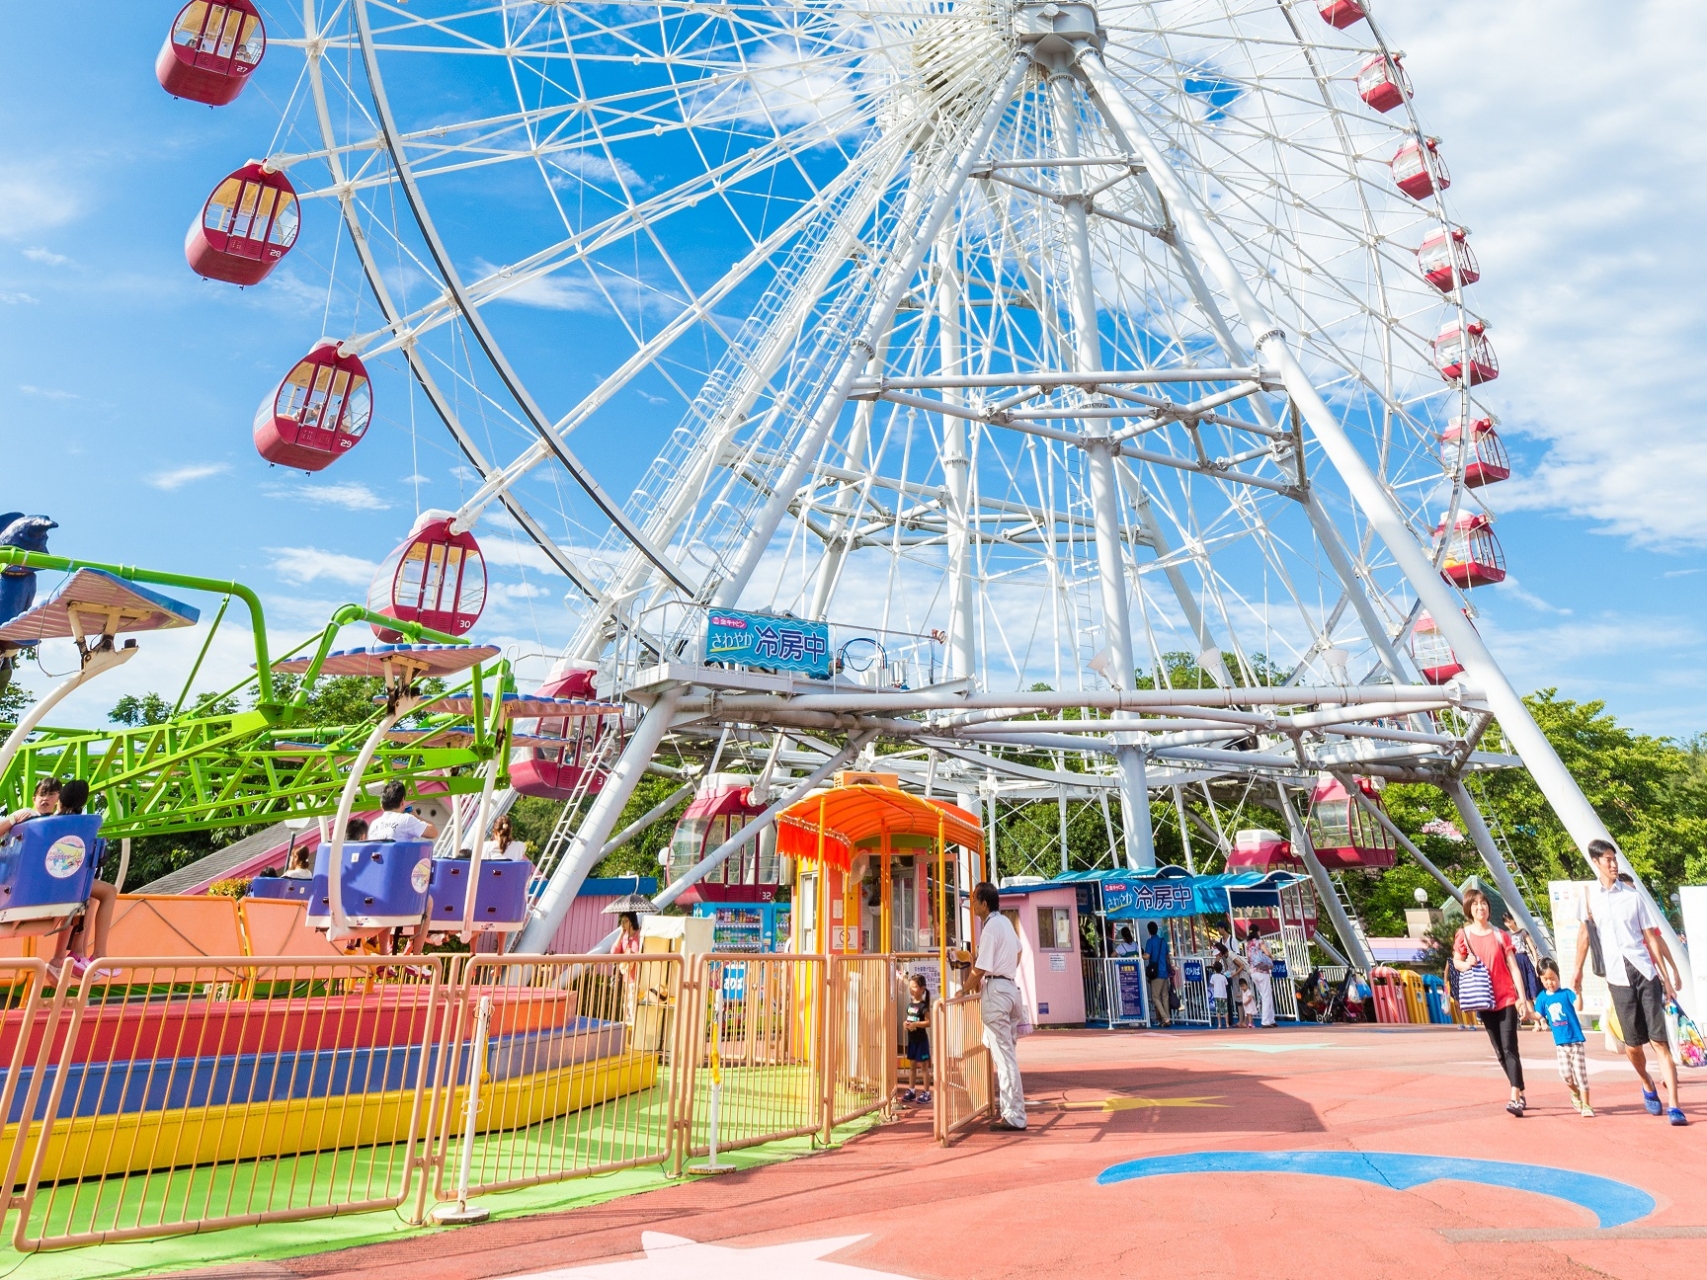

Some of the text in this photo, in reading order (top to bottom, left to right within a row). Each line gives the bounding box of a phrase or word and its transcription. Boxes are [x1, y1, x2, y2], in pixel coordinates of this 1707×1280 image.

[236, 65, 248, 73] 27
[269, 249, 282, 258] 28
[340, 439, 352, 448] 29
[459, 620, 471, 629] 30
[711, 625, 826, 664] さわやか 冷房中
[762, 891, 772, 900] 32
[1107, 883, 1193, 912] さわやか 冷房中
